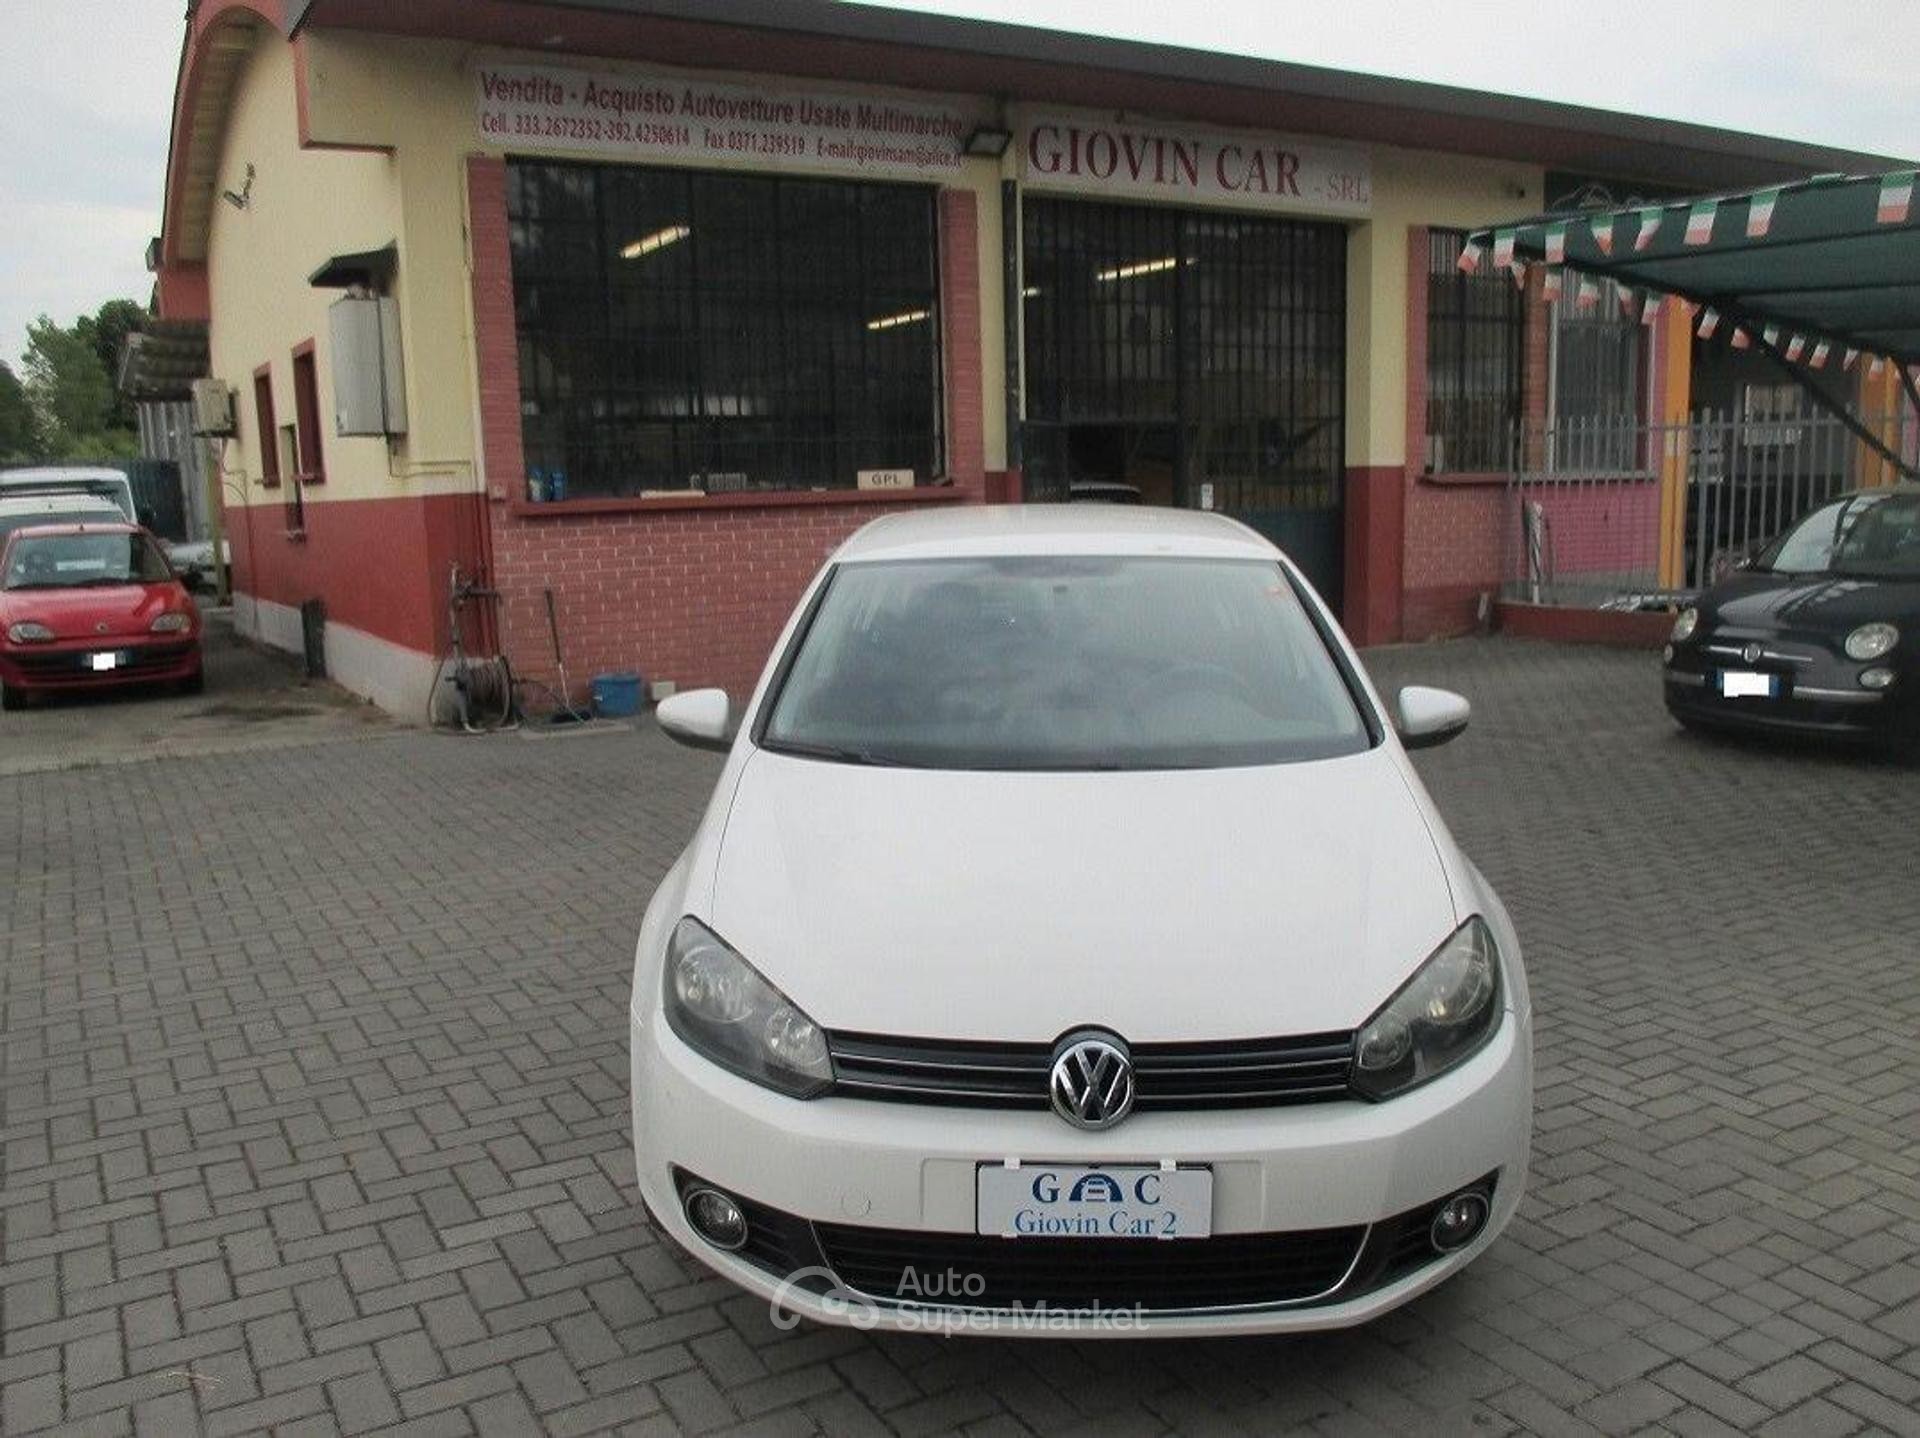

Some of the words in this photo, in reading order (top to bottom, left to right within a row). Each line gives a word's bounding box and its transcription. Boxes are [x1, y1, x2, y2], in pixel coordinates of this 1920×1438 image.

[480, 71, 564, 105] Vendita
[584, 82, 675, 117] Acquisto
[680, 89, 794, 125] Autovetture
[800, 101, 850, 129] Usate
[857, 104, 962, 137] Multimarche
[482, 111, 510, 135] Cell.
[1028, 123, 1199, 187] GIOVIN
[1215, 145, 1301, 197] CAR
[1327, 173, 1367, 203] SRL
[1014, 1209, 1099, 1235] Giovin
[1109, 1210, 1154, 1235] Car
[1161, 1210, 1177, 1235] 2
